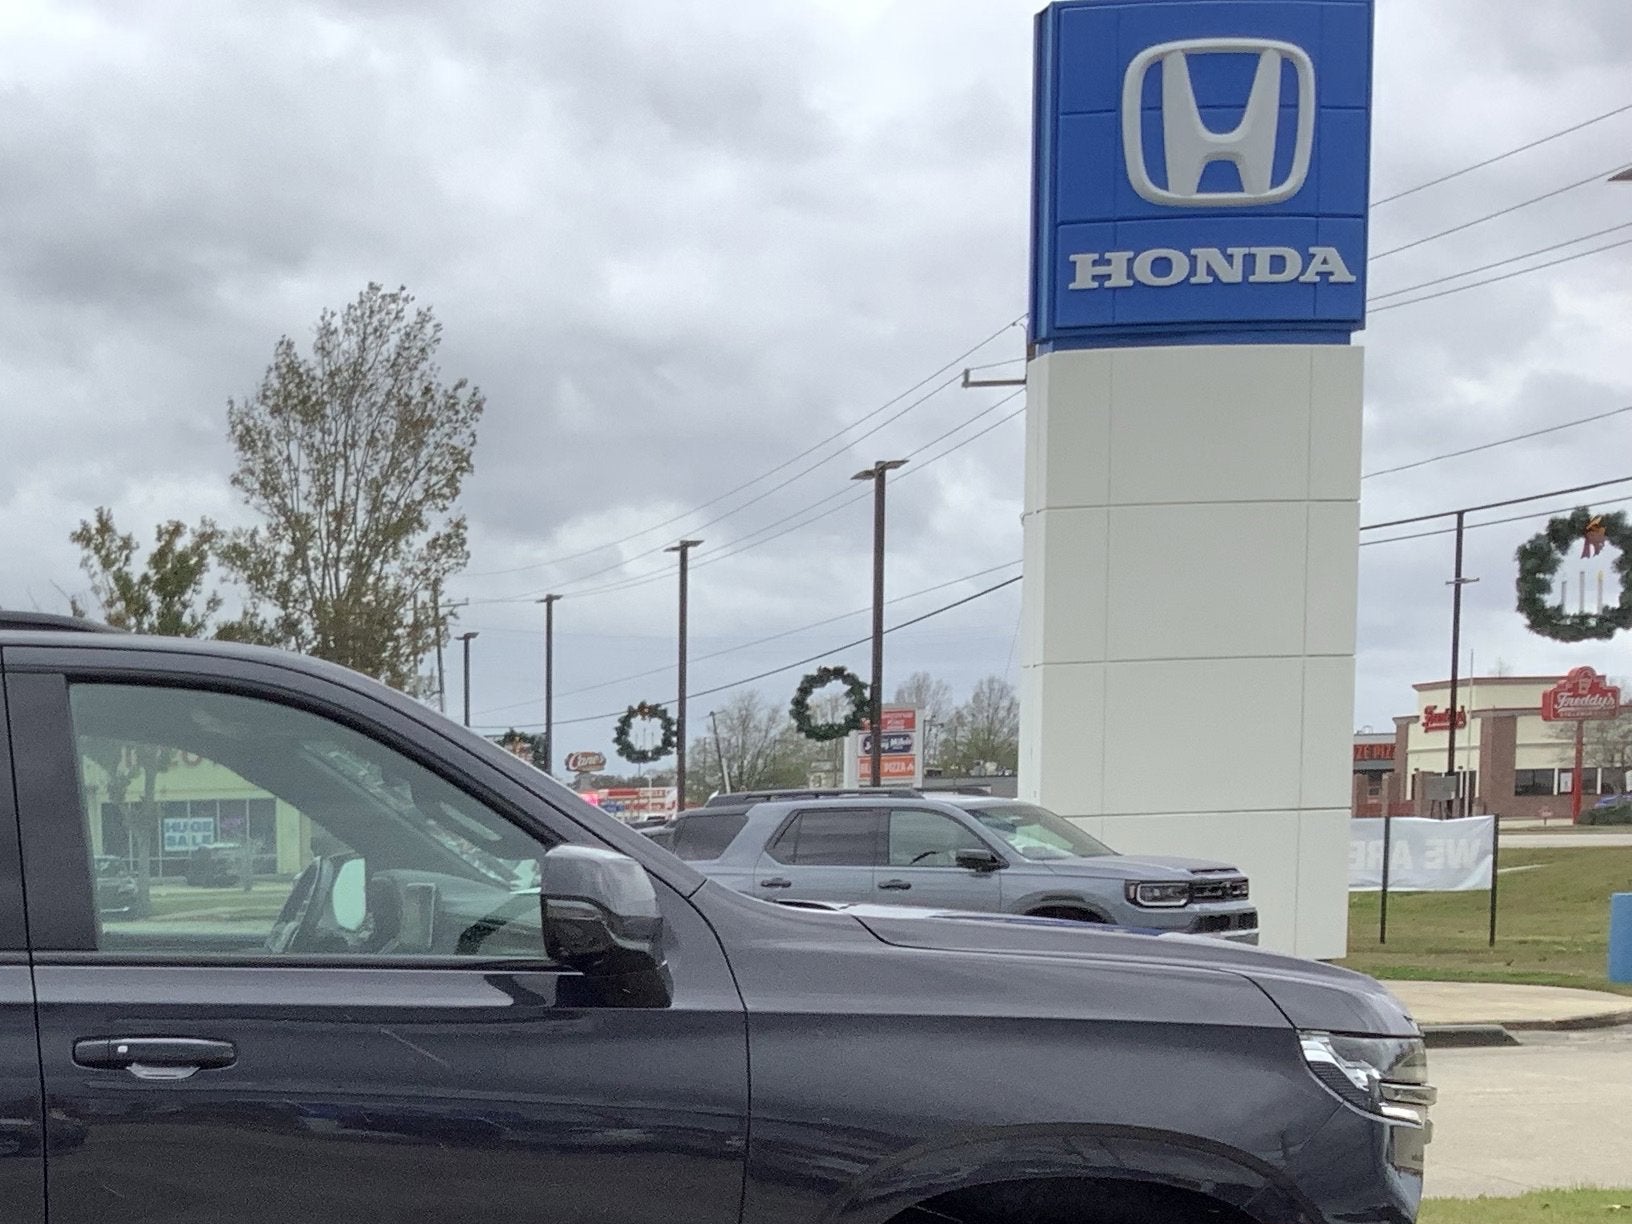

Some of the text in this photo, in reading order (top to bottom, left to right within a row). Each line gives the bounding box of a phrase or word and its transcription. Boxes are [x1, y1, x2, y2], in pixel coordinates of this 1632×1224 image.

[1068, 247, 1357, 291] HONDA
[1554, 691, 1616, 710] Freddy's
[165, 820, 213, 833] HUGE
